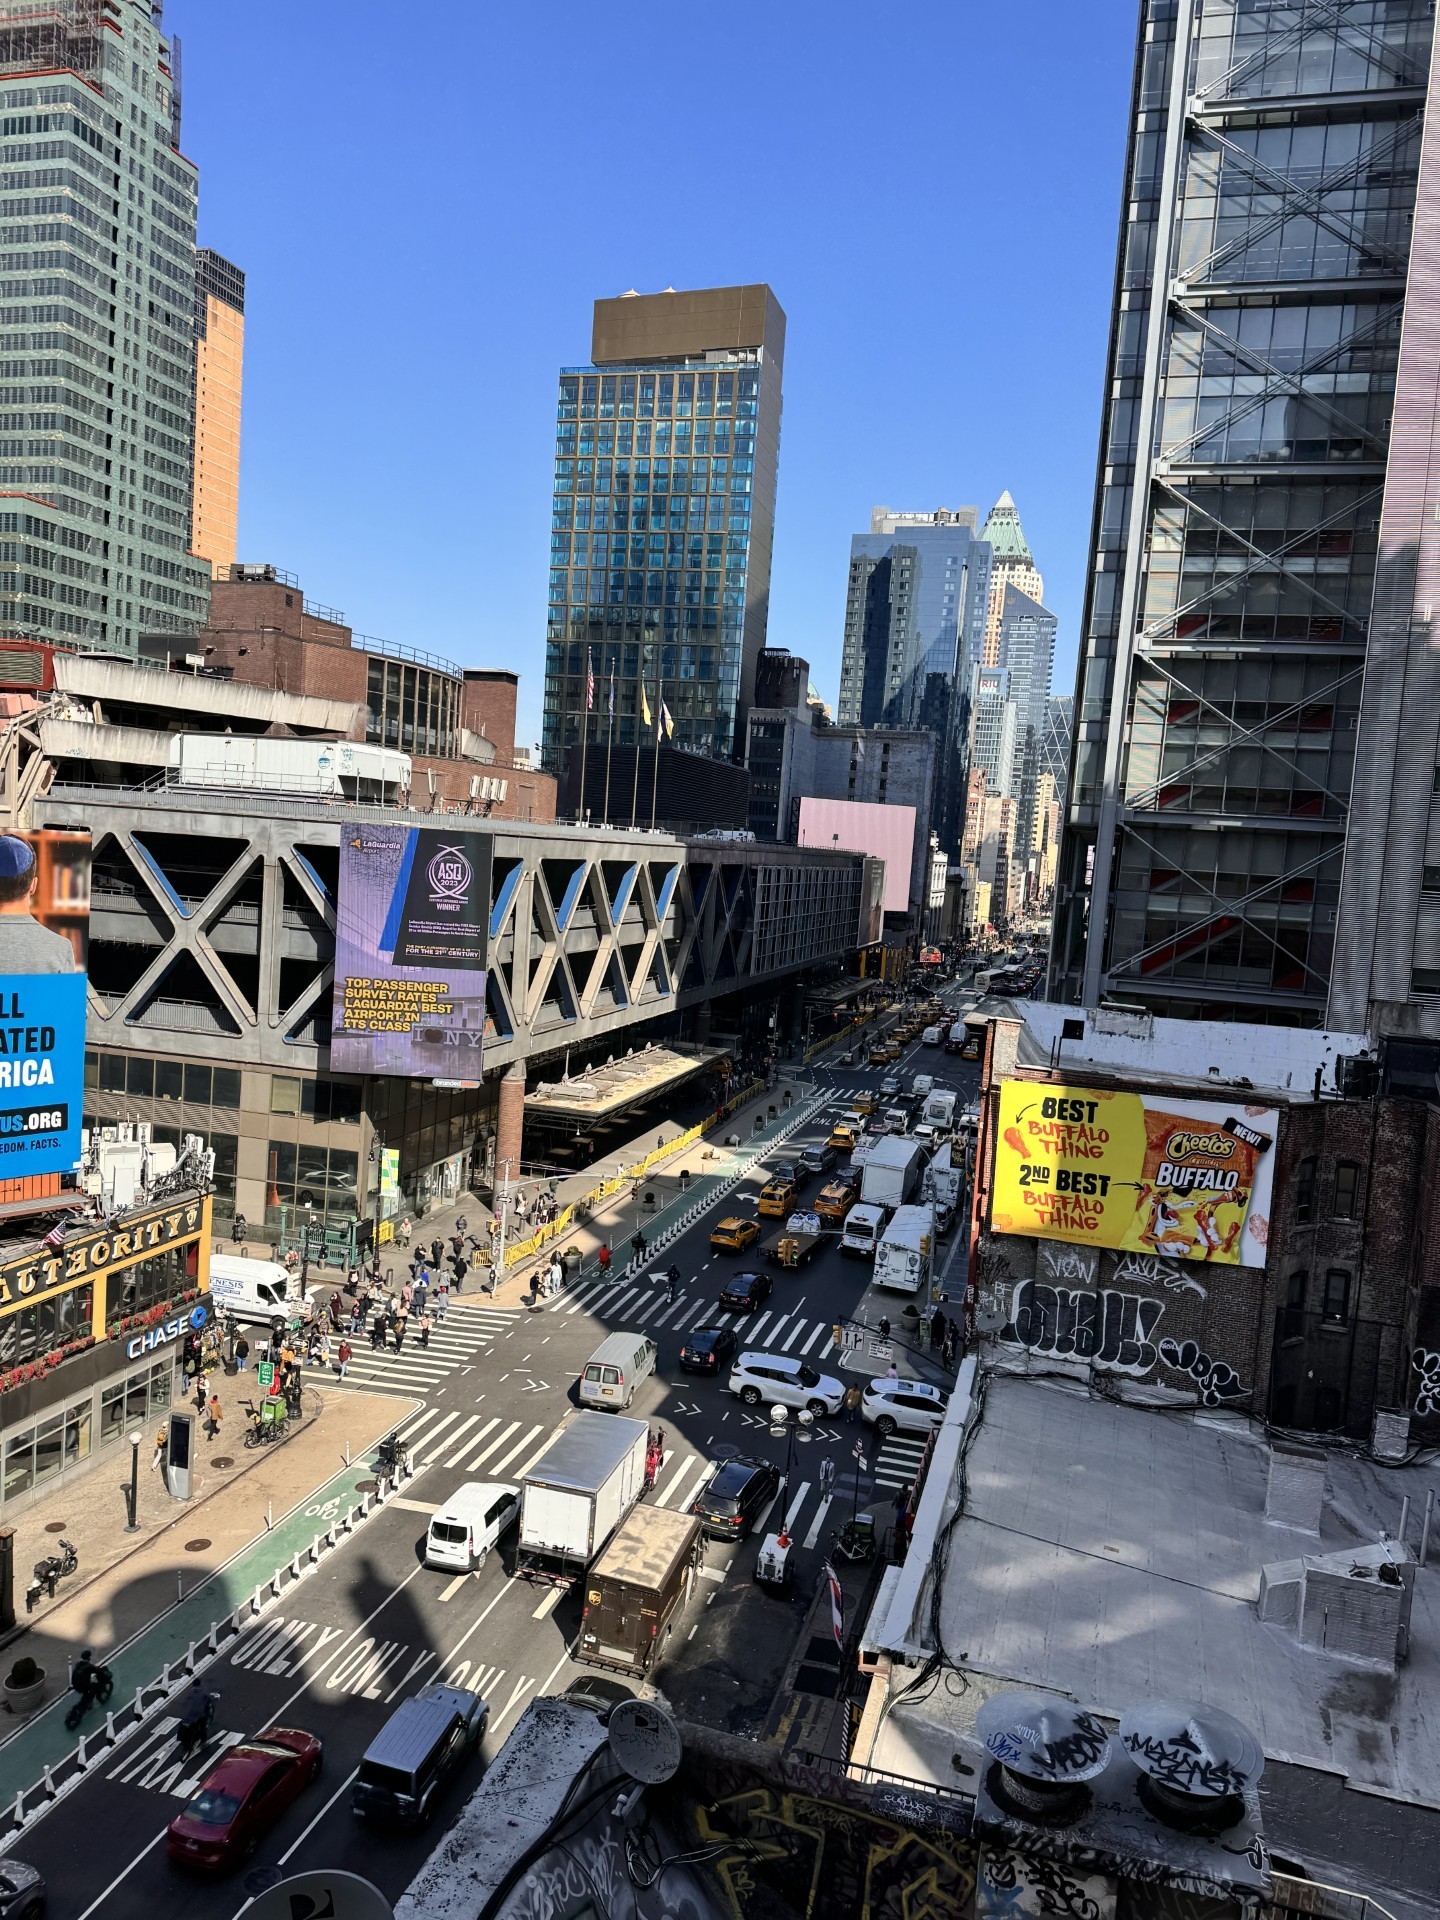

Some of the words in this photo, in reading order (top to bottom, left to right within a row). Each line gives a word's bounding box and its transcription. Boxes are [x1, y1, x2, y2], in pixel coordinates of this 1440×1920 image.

[981, 679, 1000, 688] RIU
[362, 839, 401, 850] LaGuardia
[437, 862, 463, 881] ASQ
[440, 879, 459, 887] 2023
[436, 903, 461, 912] WINNER
[345, 988, 394, 1000] SURVEY
[397, 991, 437, 1002] RATES
[346, 977, 371, 988] TOP
[373, 979, 449, 994] PASSENGER
[344, 1009, 401, 1021] AIRPORT
[404, 1012, 420, 1022] IN
[345, 999, 419, 1012] LAGUARDIA
[421, 1003, 453, 1014] BEST
[344, 1019, 367, 1029] ITS
[369, 1021, 411, 1032] CLASS
[444, 1029, 482, 1048] NY
[1041, 1096, 1099, 1124] BEST
[1027, 1120, 1110, 1144] BUFFALO
[1232, 1124, 1263, 1146] NEW!
[30, 1138, 61, 1151] FACTS.
[1038, 1136, 1105, 1160] THING
[1167, 1132, 1236, 1160] Cheetos
[1019, 1164, 1051, 1187] 2ND
[1056, 1169, 1111, 1197] BEST
[1155, 1161, 1240, 1191] BUFFALO
[1023, 1190, 1105, 1215] BUFFALO
[1033, 1207, 1100, 1231] THING
[128, 1314, 191, 1360] CHASE
[230, 1616, 344, 1678] ONLY
[325, 1637, 437, 1703] ONLY
